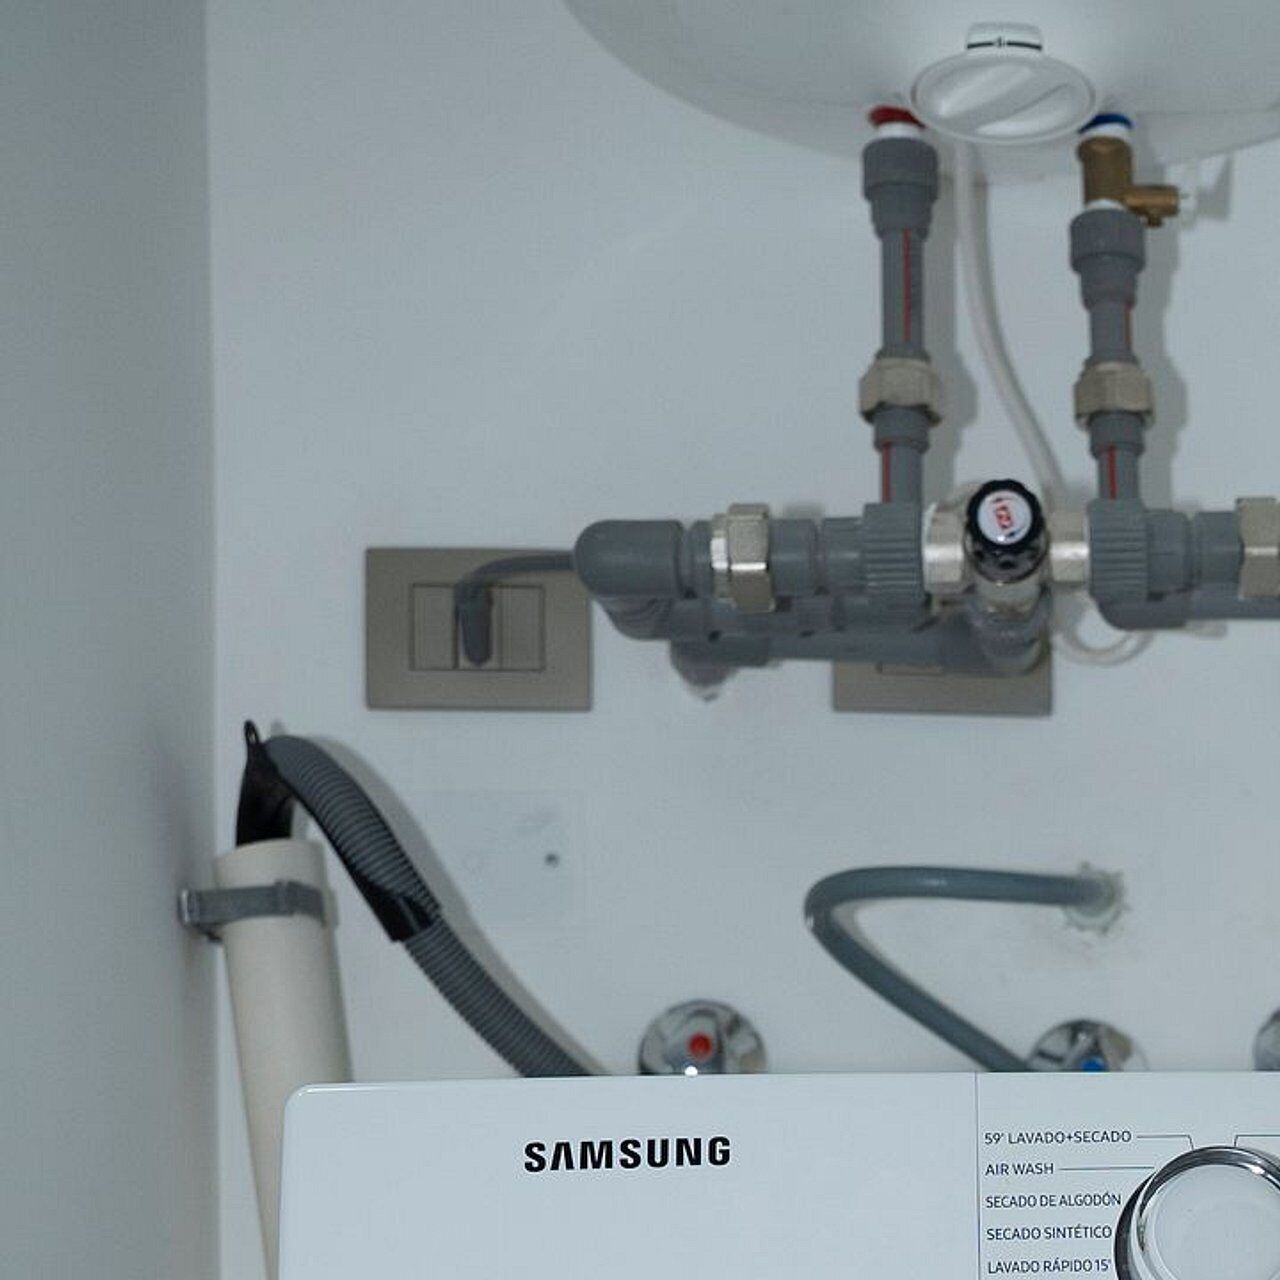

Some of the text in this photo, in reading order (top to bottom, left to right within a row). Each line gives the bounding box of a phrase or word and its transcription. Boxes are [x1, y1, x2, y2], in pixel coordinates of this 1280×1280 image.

[1008, 1130, 1132, 1145] LAVADO+SECADO
[524, 1136, 731, 1173] SAMSUNG
[985, 1162, 1054, 1176] AIR WASH
[985, 1191, 1122, 1209] SECADO DE ALGODÓN
[986, 1224, 1112, 1241] SECADO SINTÉTICO
[988, 1260, 1040, 1274] LAVADO
[1043, 1257, 1093, 1273] RÁPIDO
